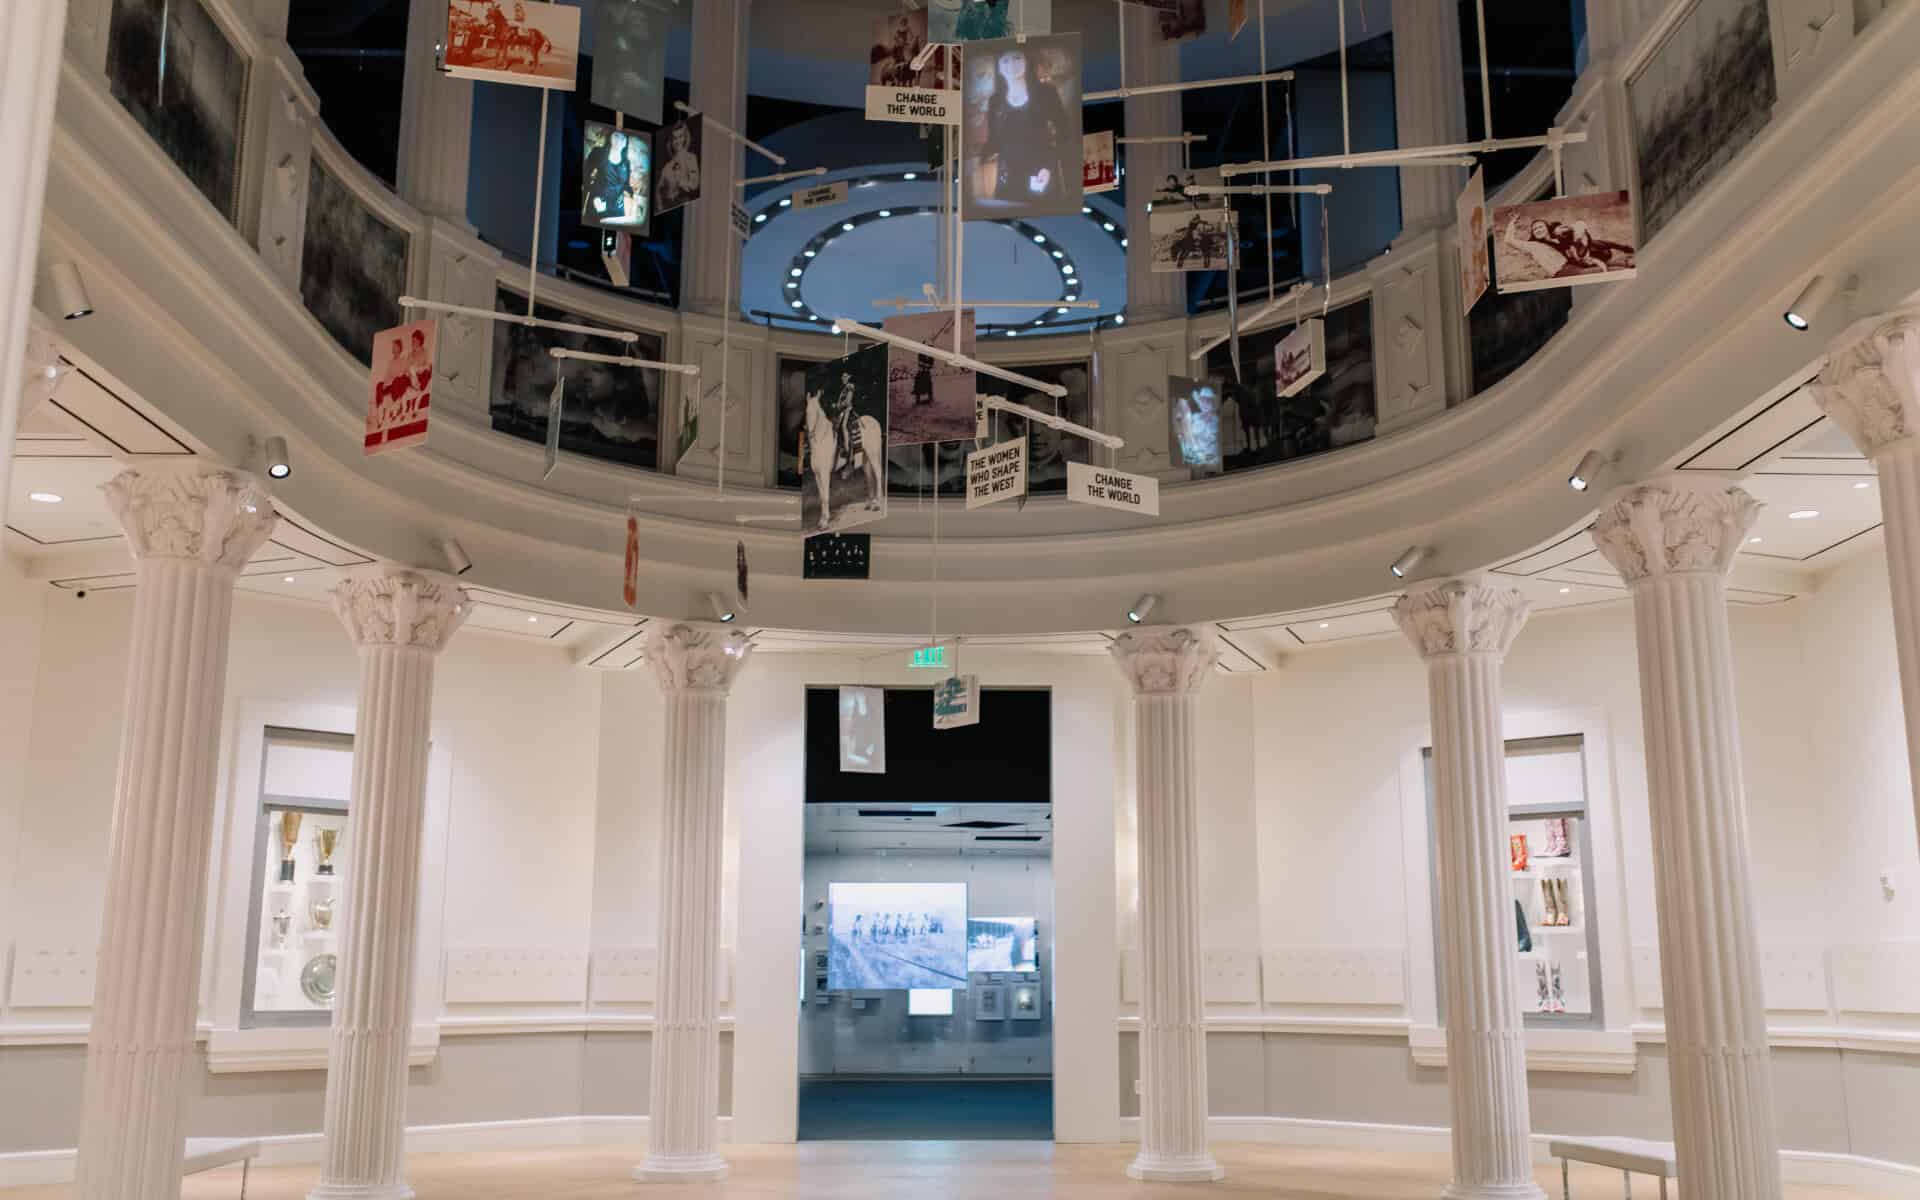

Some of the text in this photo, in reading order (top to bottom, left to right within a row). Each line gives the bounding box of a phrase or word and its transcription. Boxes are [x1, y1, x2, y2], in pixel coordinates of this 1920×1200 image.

[896, 92, 937, 104] CHANGE
[887, 103, 946, 117] THE WORLD
[970, 446, 1020, 472] THE WOMEN
[970, 460, 1020, 485] WHO SHAPE
[1095, 472, 1133, 490] CHANGE
[974, 476, 1015, 497] THE WEST
[1087, 484, 1141, 505] THE WORLD
[913, 646, 945, 665] EXIT
